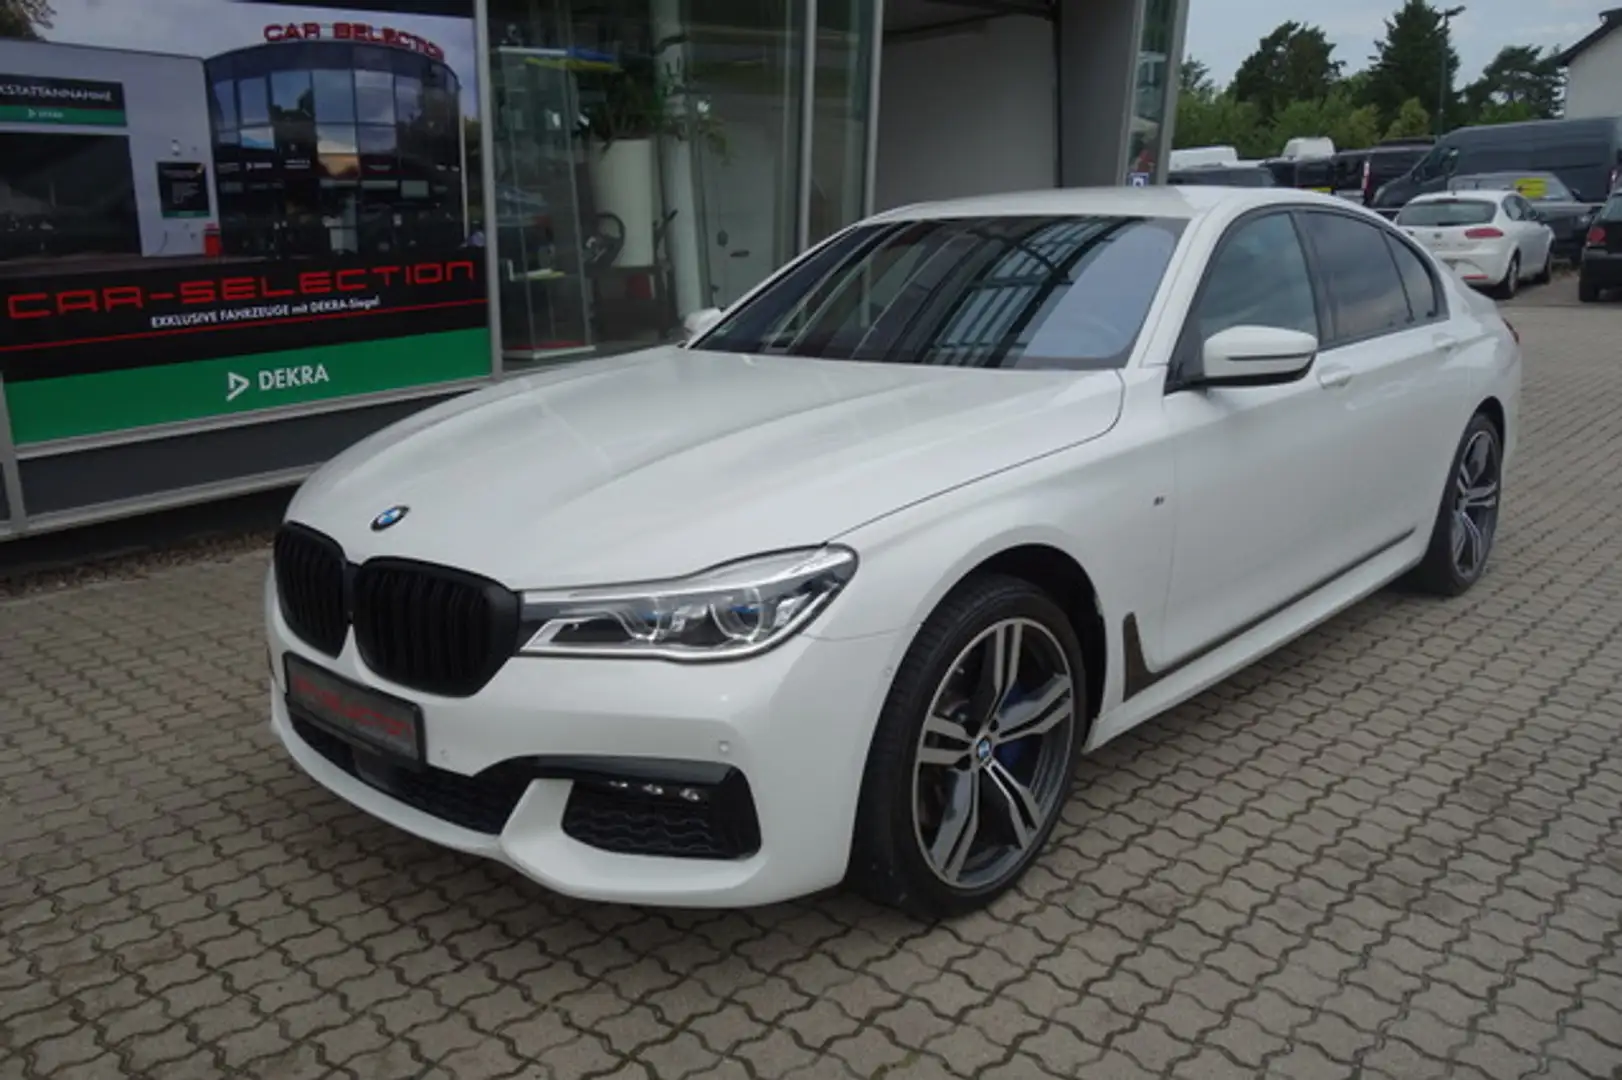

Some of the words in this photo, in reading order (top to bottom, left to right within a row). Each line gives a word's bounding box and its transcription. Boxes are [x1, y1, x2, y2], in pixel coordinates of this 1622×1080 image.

[263, 22, 321, 41] CAR
[8, 260, 474, 320] CAR-SELECTION
[151, 310, 217, 328] EXKLUSIVE
[220, 303, 290, 321] FAHRZEUGE
[292, 303, 308, 314] mit
[258, 363, 330, 391] DEKRA
